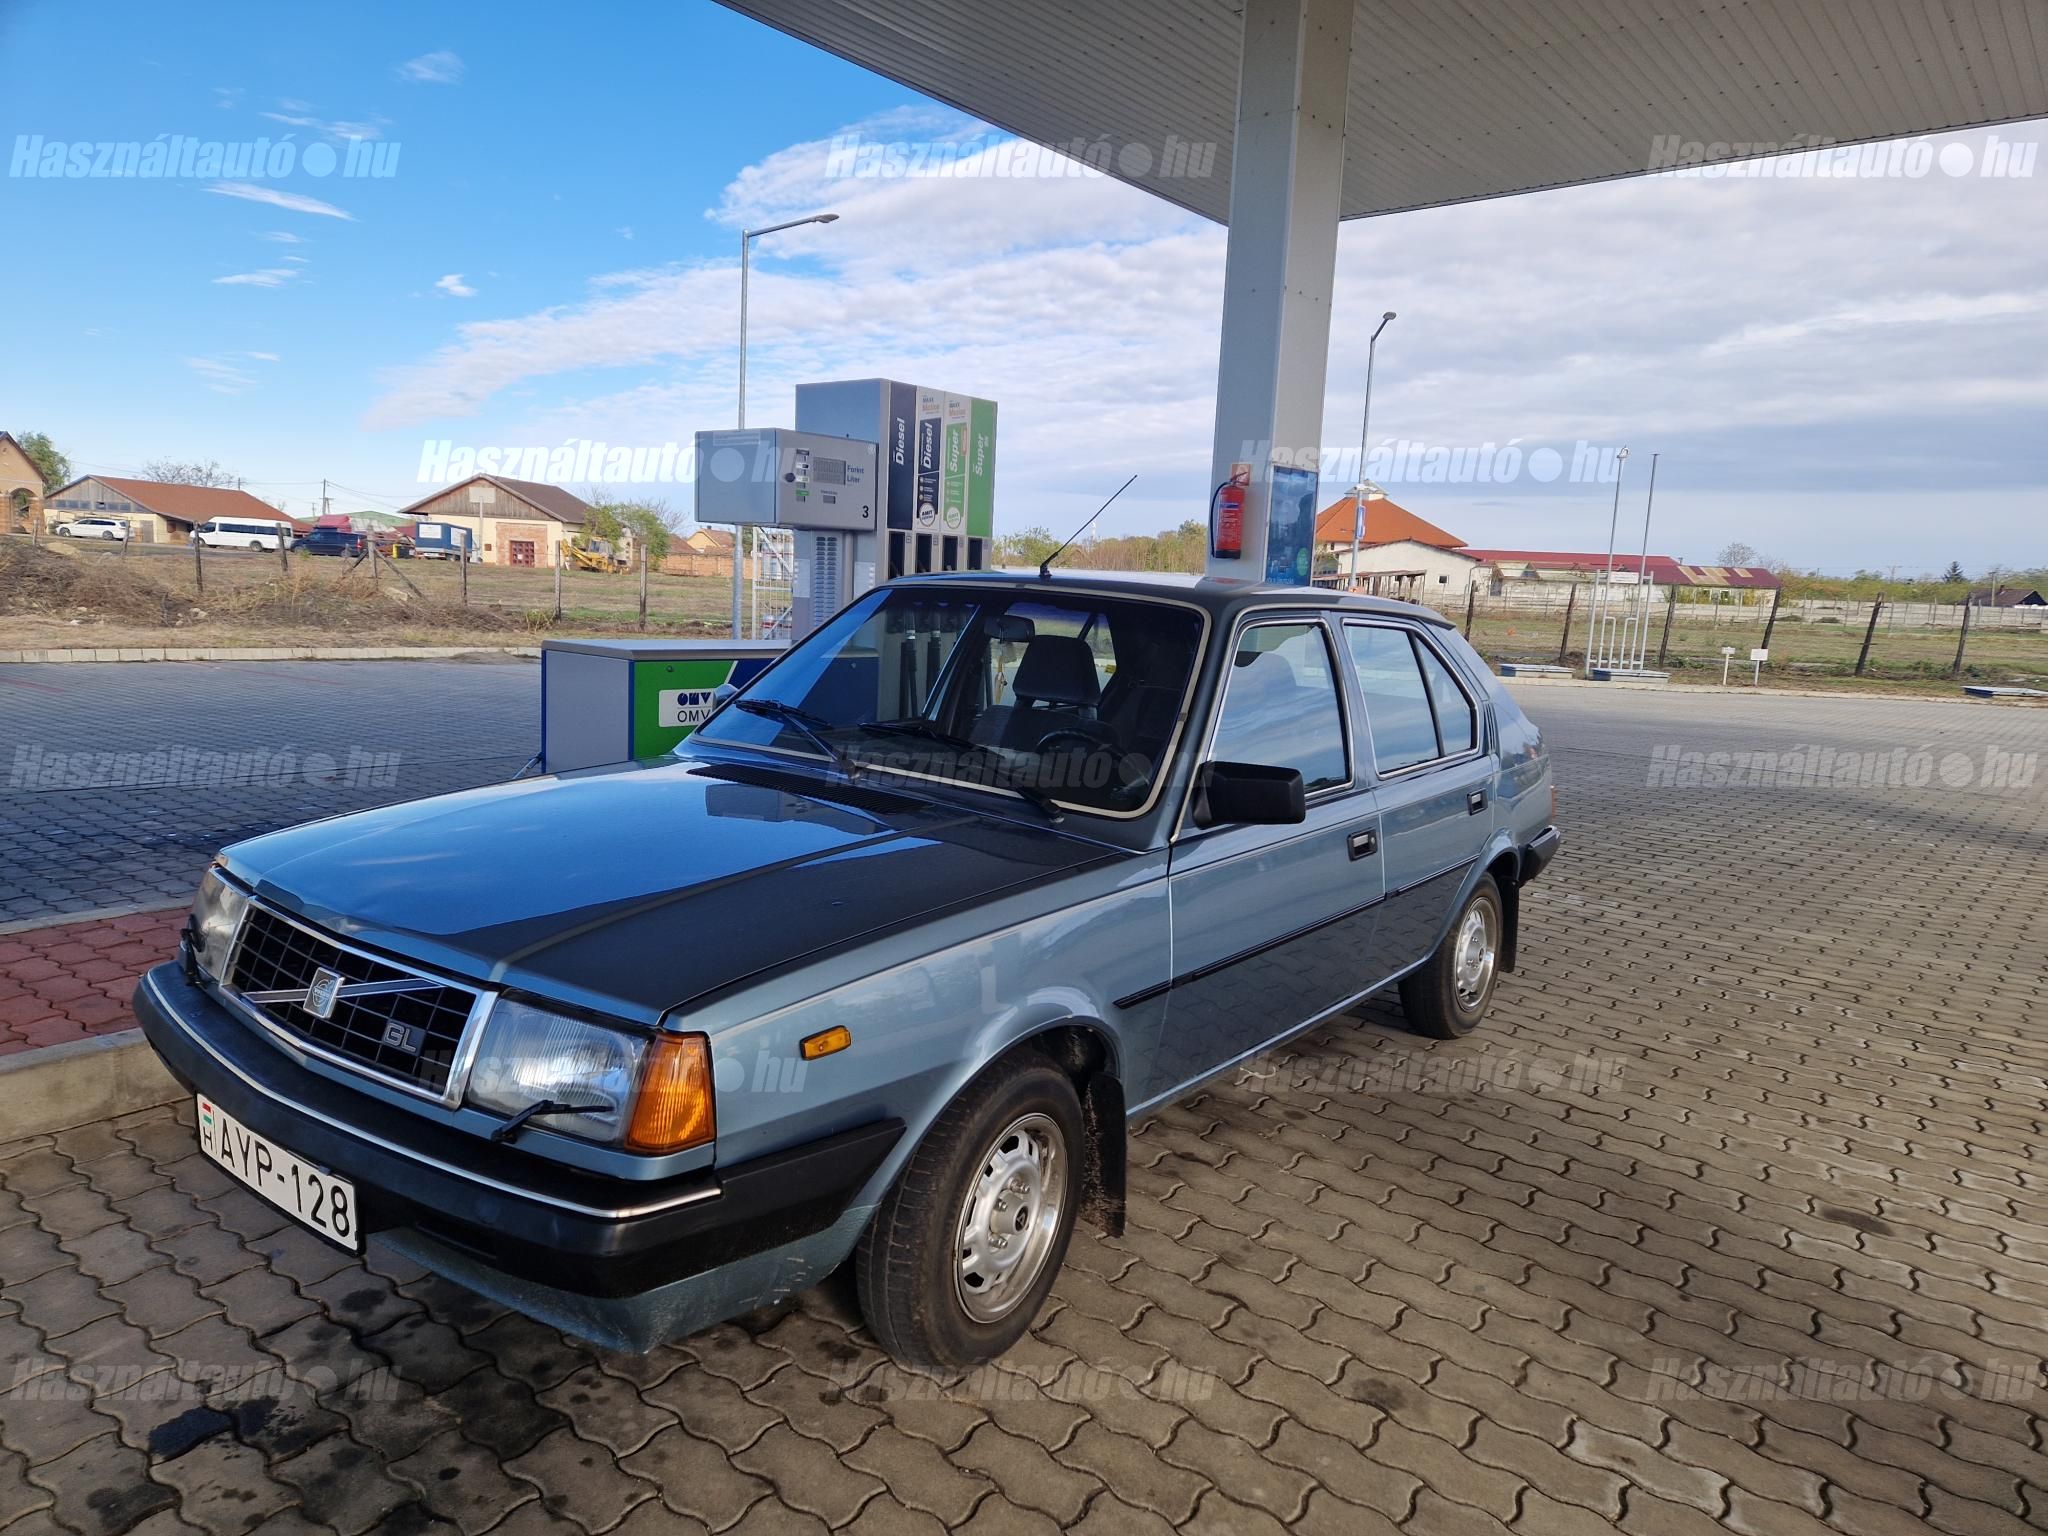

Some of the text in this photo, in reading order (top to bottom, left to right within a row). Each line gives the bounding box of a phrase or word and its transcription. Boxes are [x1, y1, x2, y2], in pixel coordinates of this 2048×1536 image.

[895, 417, 905, 466] Diesel
[923, 422, 933, 469] Diesel
[950, 428, 959, 473] Super
[975, 433, 984, 476] Super
[862, 505, 869, 518] 3
[677, 709, 711, 723] OMV
[383, 1022, 417, 1053] GL
[203, 1118, 350, 1238] H AYP-128
